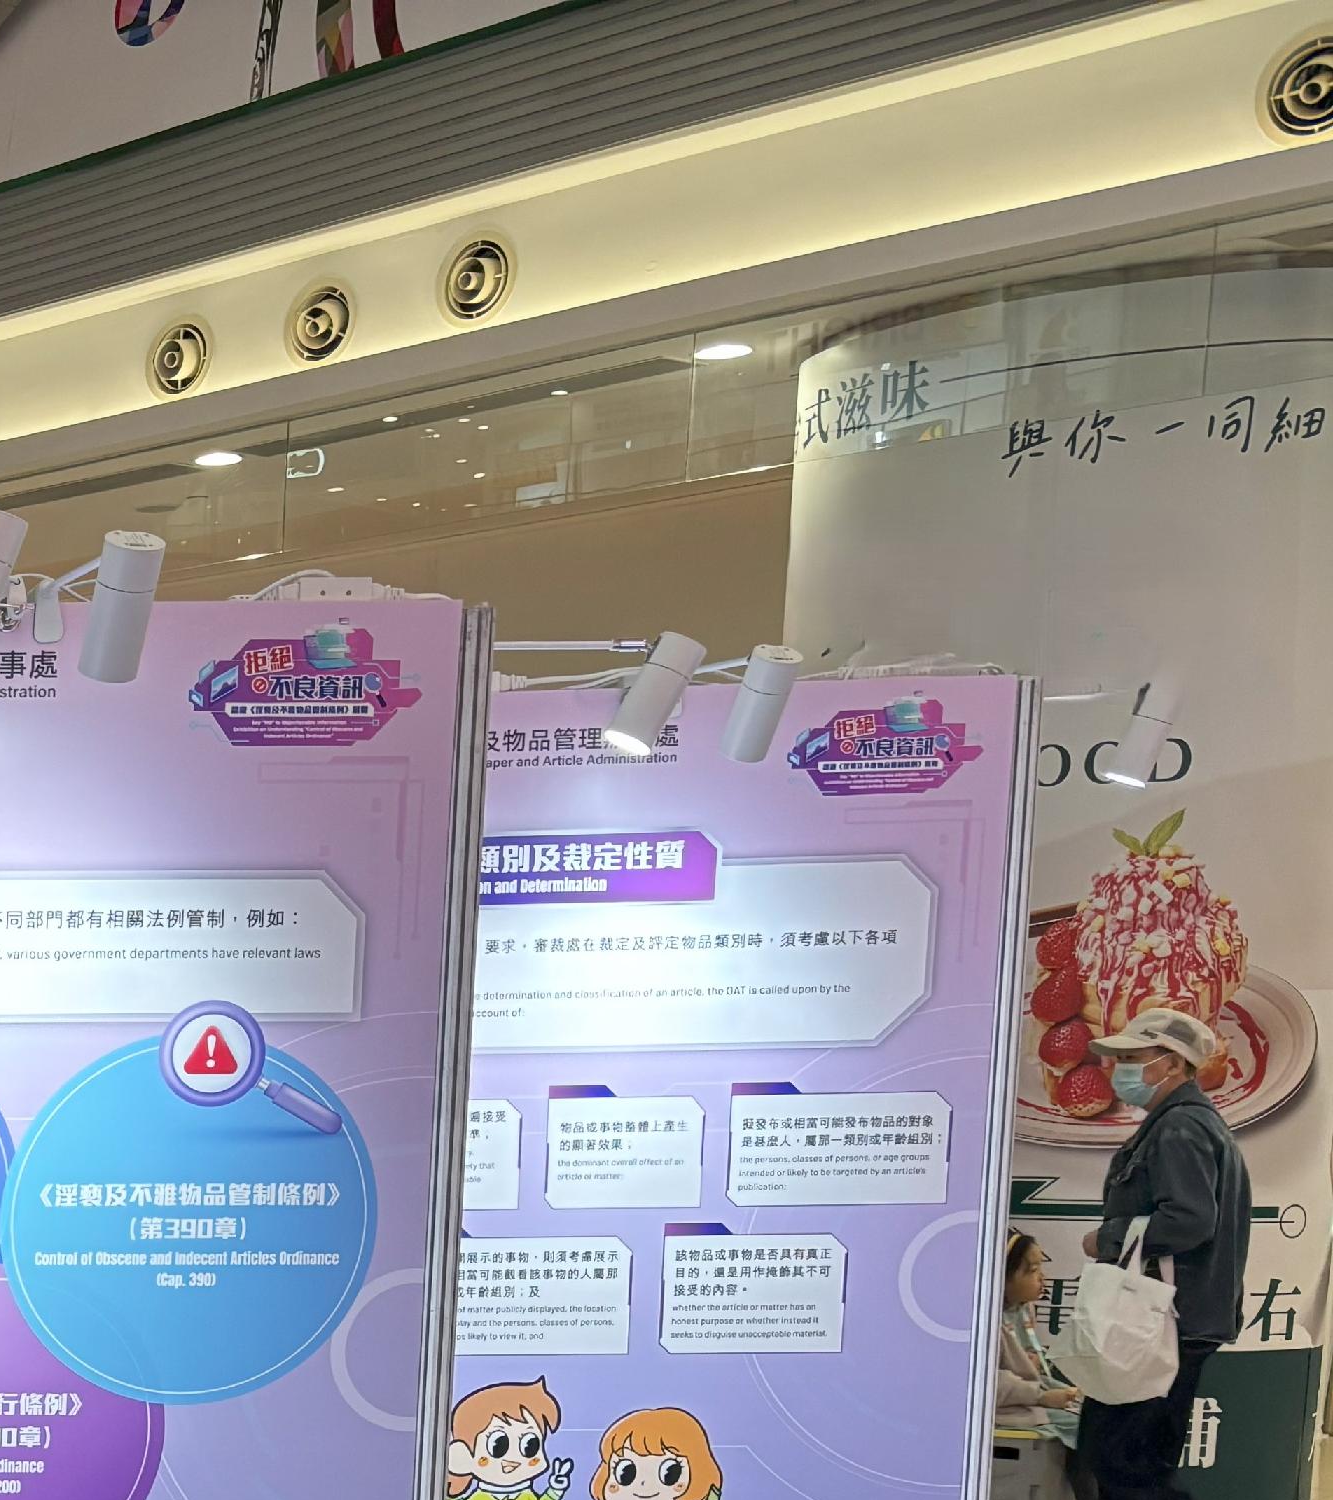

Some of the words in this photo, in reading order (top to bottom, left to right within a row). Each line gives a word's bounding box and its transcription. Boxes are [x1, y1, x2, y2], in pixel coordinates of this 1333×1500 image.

[1000, 395, 1325, 479] 與你一同細
[245, 645, 292, 675] 拒絕
[269, 675, 363, 699] 不良資訊
[835, 715, 875, 739] 拒絕
[855, 737, 934, 757] 不良資訊
[517, 757, 539, 766] and
[543, 755, 583, 766] Article
[587, 753, 677, 765] Administration
[495, 879, 517, 894] and
[520, 877, 607, 894] Determination
[54, 949, 125, 962] government
[129, 948, 208, 962] departments
[211, 948, 239, 959] have
[242, 948, 291, 959] relevant
[294, 948, 321, 959] laws
[35, 1251, 78, 1266] Control
[81, 1251, 93, 1266] of
[95, 1251, 147, 1266] Obscene
[150, 1251, 172, 1266] and
[174, 1251, 228, 1266] Indecent
[231, 1251, 277, 1266] Articles
[279, 1251, 340, 1266] Ordinance
[156, 1273, 186, 1289] (Cap.
[189, 1272, 216, 1288] 390)
